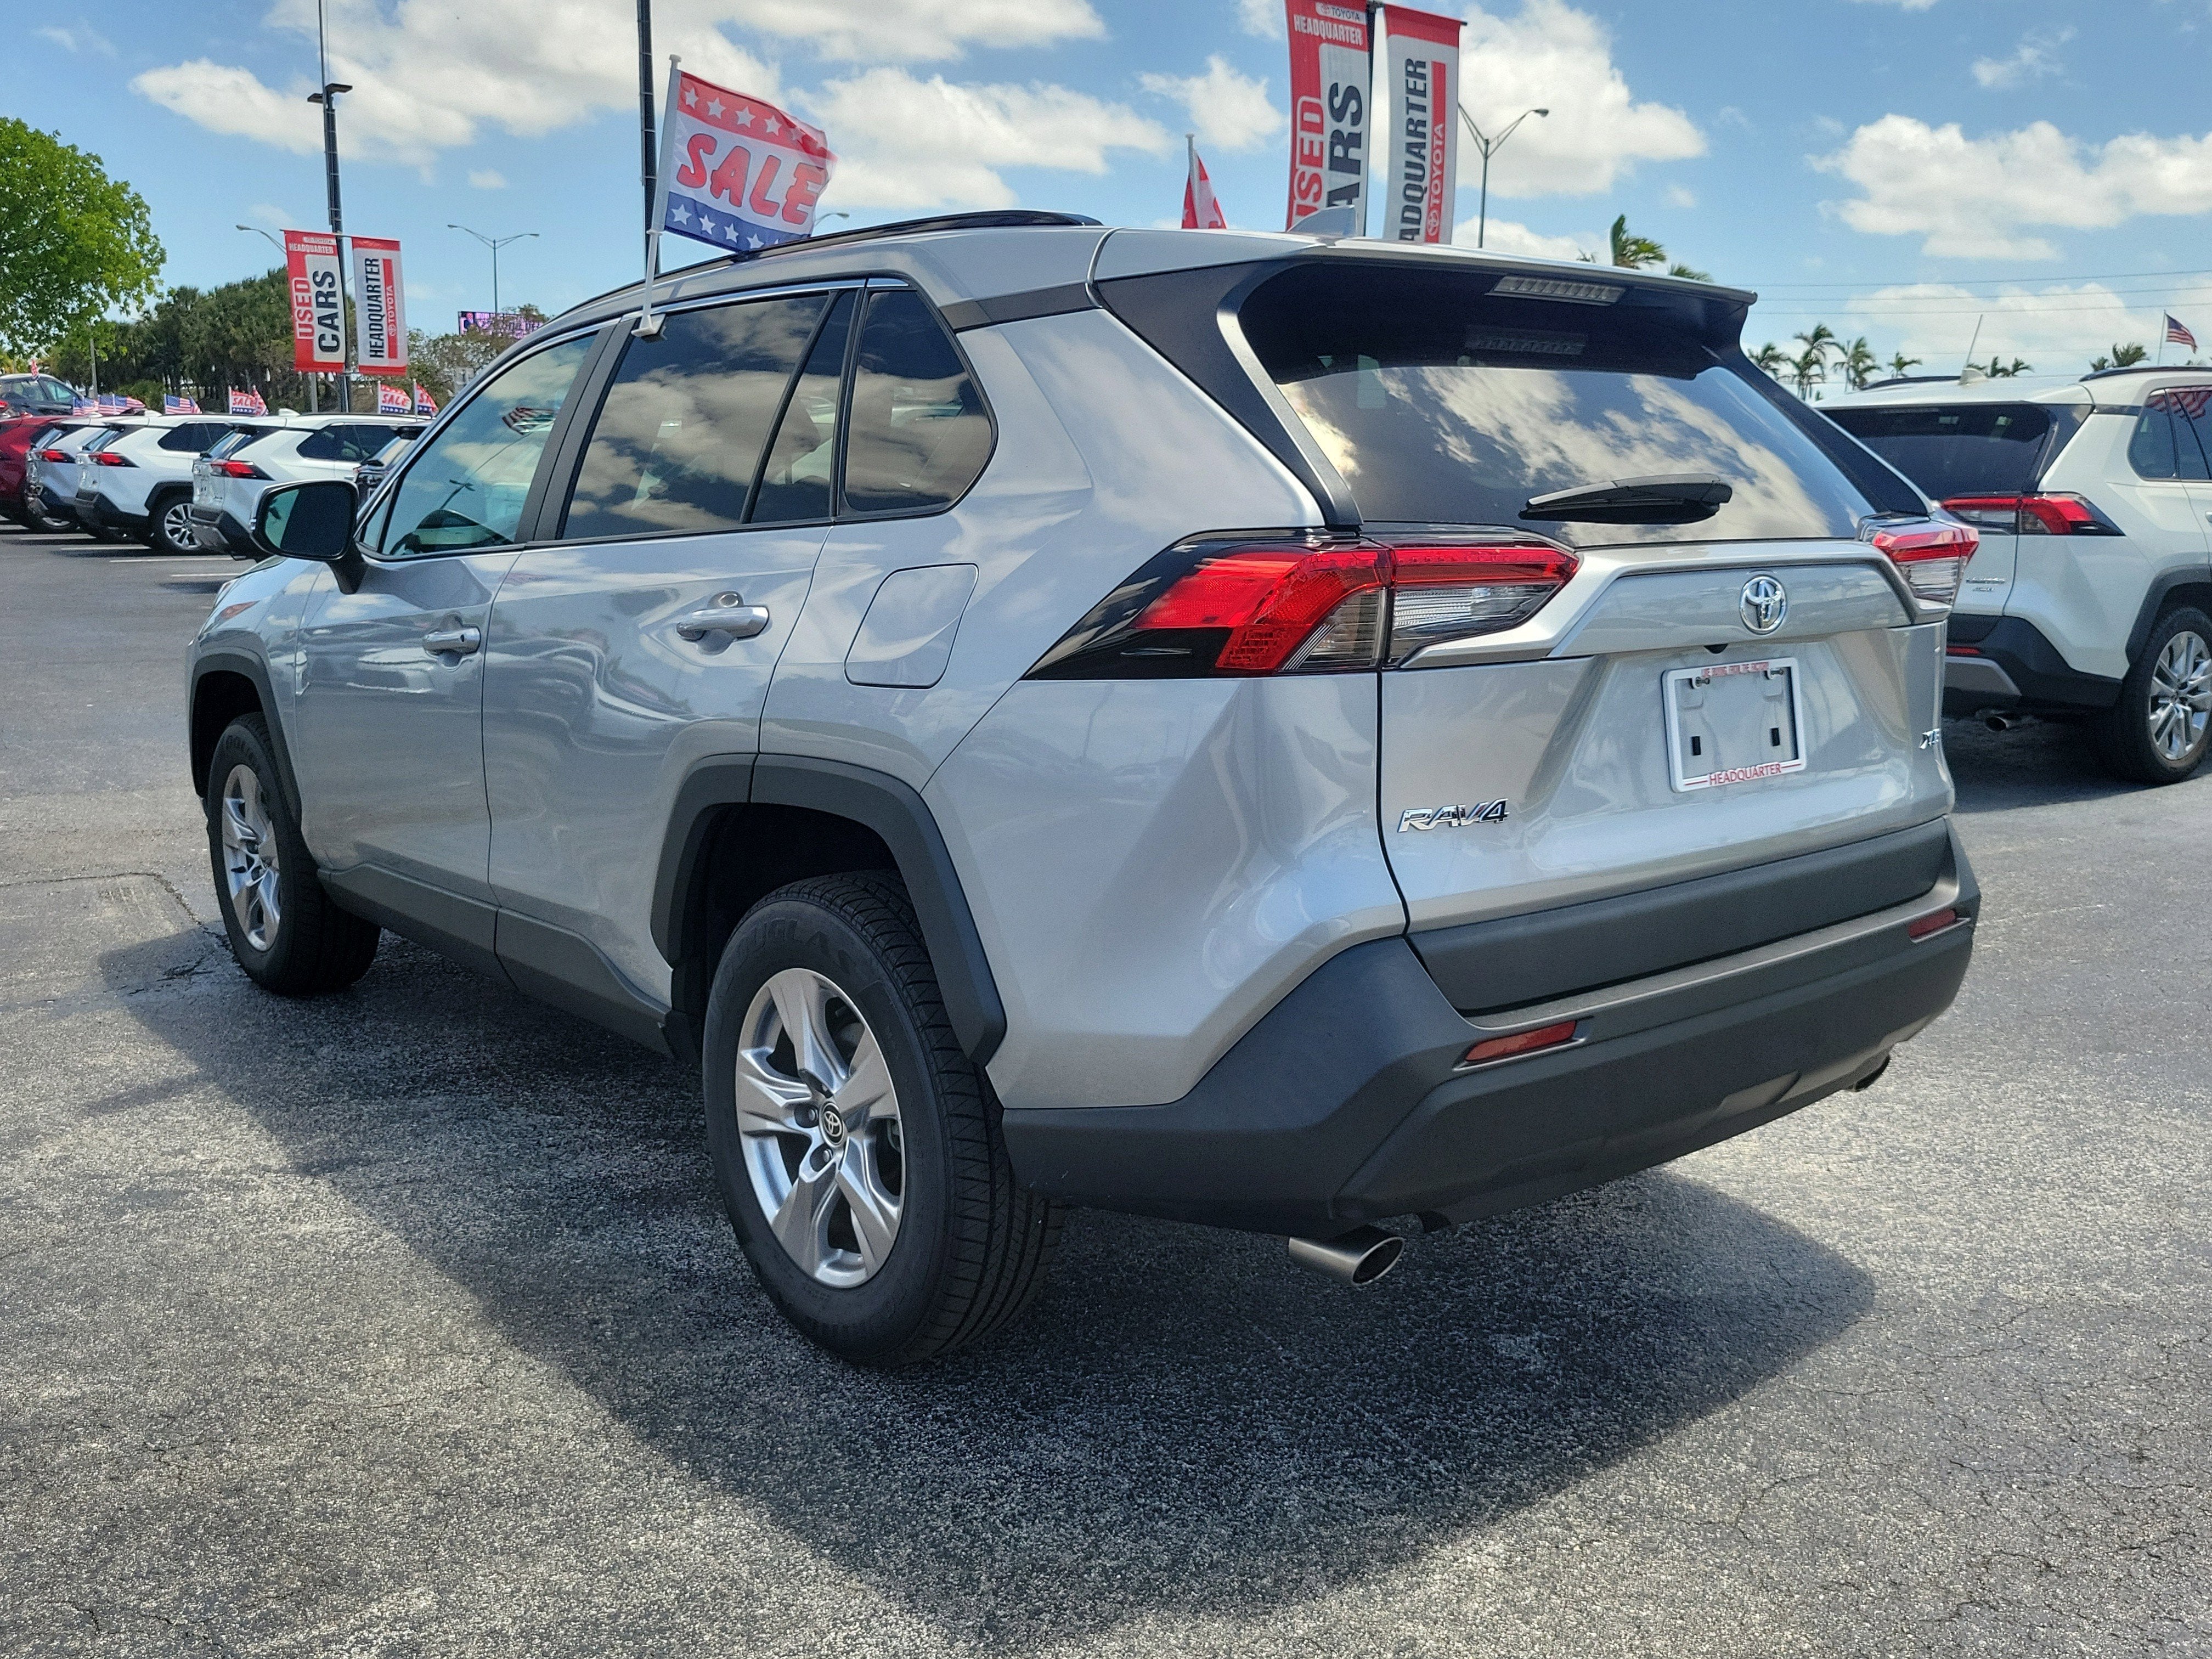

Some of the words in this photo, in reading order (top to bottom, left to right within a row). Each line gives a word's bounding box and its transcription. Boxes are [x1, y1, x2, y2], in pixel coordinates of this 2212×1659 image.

[1293, 14, 1362, 46] HEADQUARTER
[1331, 7, 1360, 21] TOYOTA
[1327, 83, 1362, 207] ARS
[1398, 58, 1427, 241] ADQUARTER
[1431, 123, 1444, 206] TOYOTA
[676, 133, 828, 225] SALE
[289, 242, 334, 254] HEADQUARTER
[294, 279, 315, 338] USED
[313, 270, 340, 353] CARS
[365, 258, 385, 358] HEADQUARTER
[386, 285, 396, 325] TOYOTA
[233, 398, 256, 407] SALE
[382, 394, 409, 407] SALE
[1709, 763, 1782, 785] HEADQUARTER
[1397, 798, 1510, 832] RAV4
